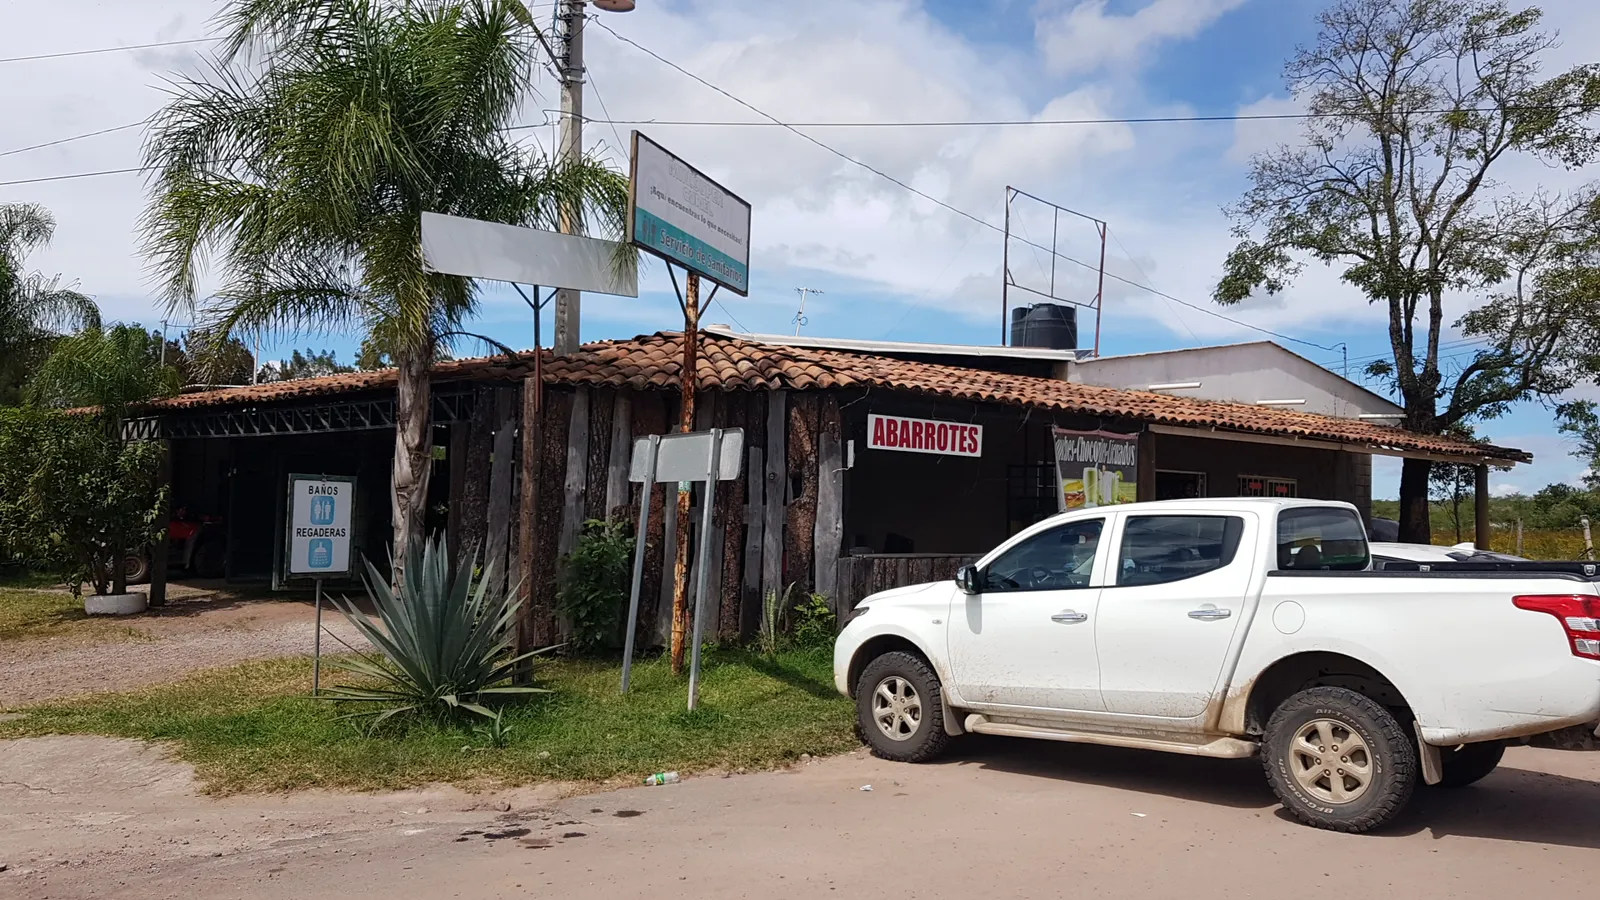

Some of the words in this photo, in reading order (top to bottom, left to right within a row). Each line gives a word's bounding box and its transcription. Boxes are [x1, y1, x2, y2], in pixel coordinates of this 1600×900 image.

[668, 197, 700, 221] encuentras
[701, 214, 706, 224] lo
[707, 220, 717, 231] que
[660, 229, 694, 259] Servicio
[696, 247, 706, 265] de
[707, 254, 743, 283] Sanitarios
[873, 417, 979, 453] ABARROTES
[308, 484, 339, 496] BAÑOS
[296, 528, 346, 538] REGADERAS
[1316, 709, 1375, 747] All-Terrain
[1278, 758, 1334, 813] BFGoodrich
